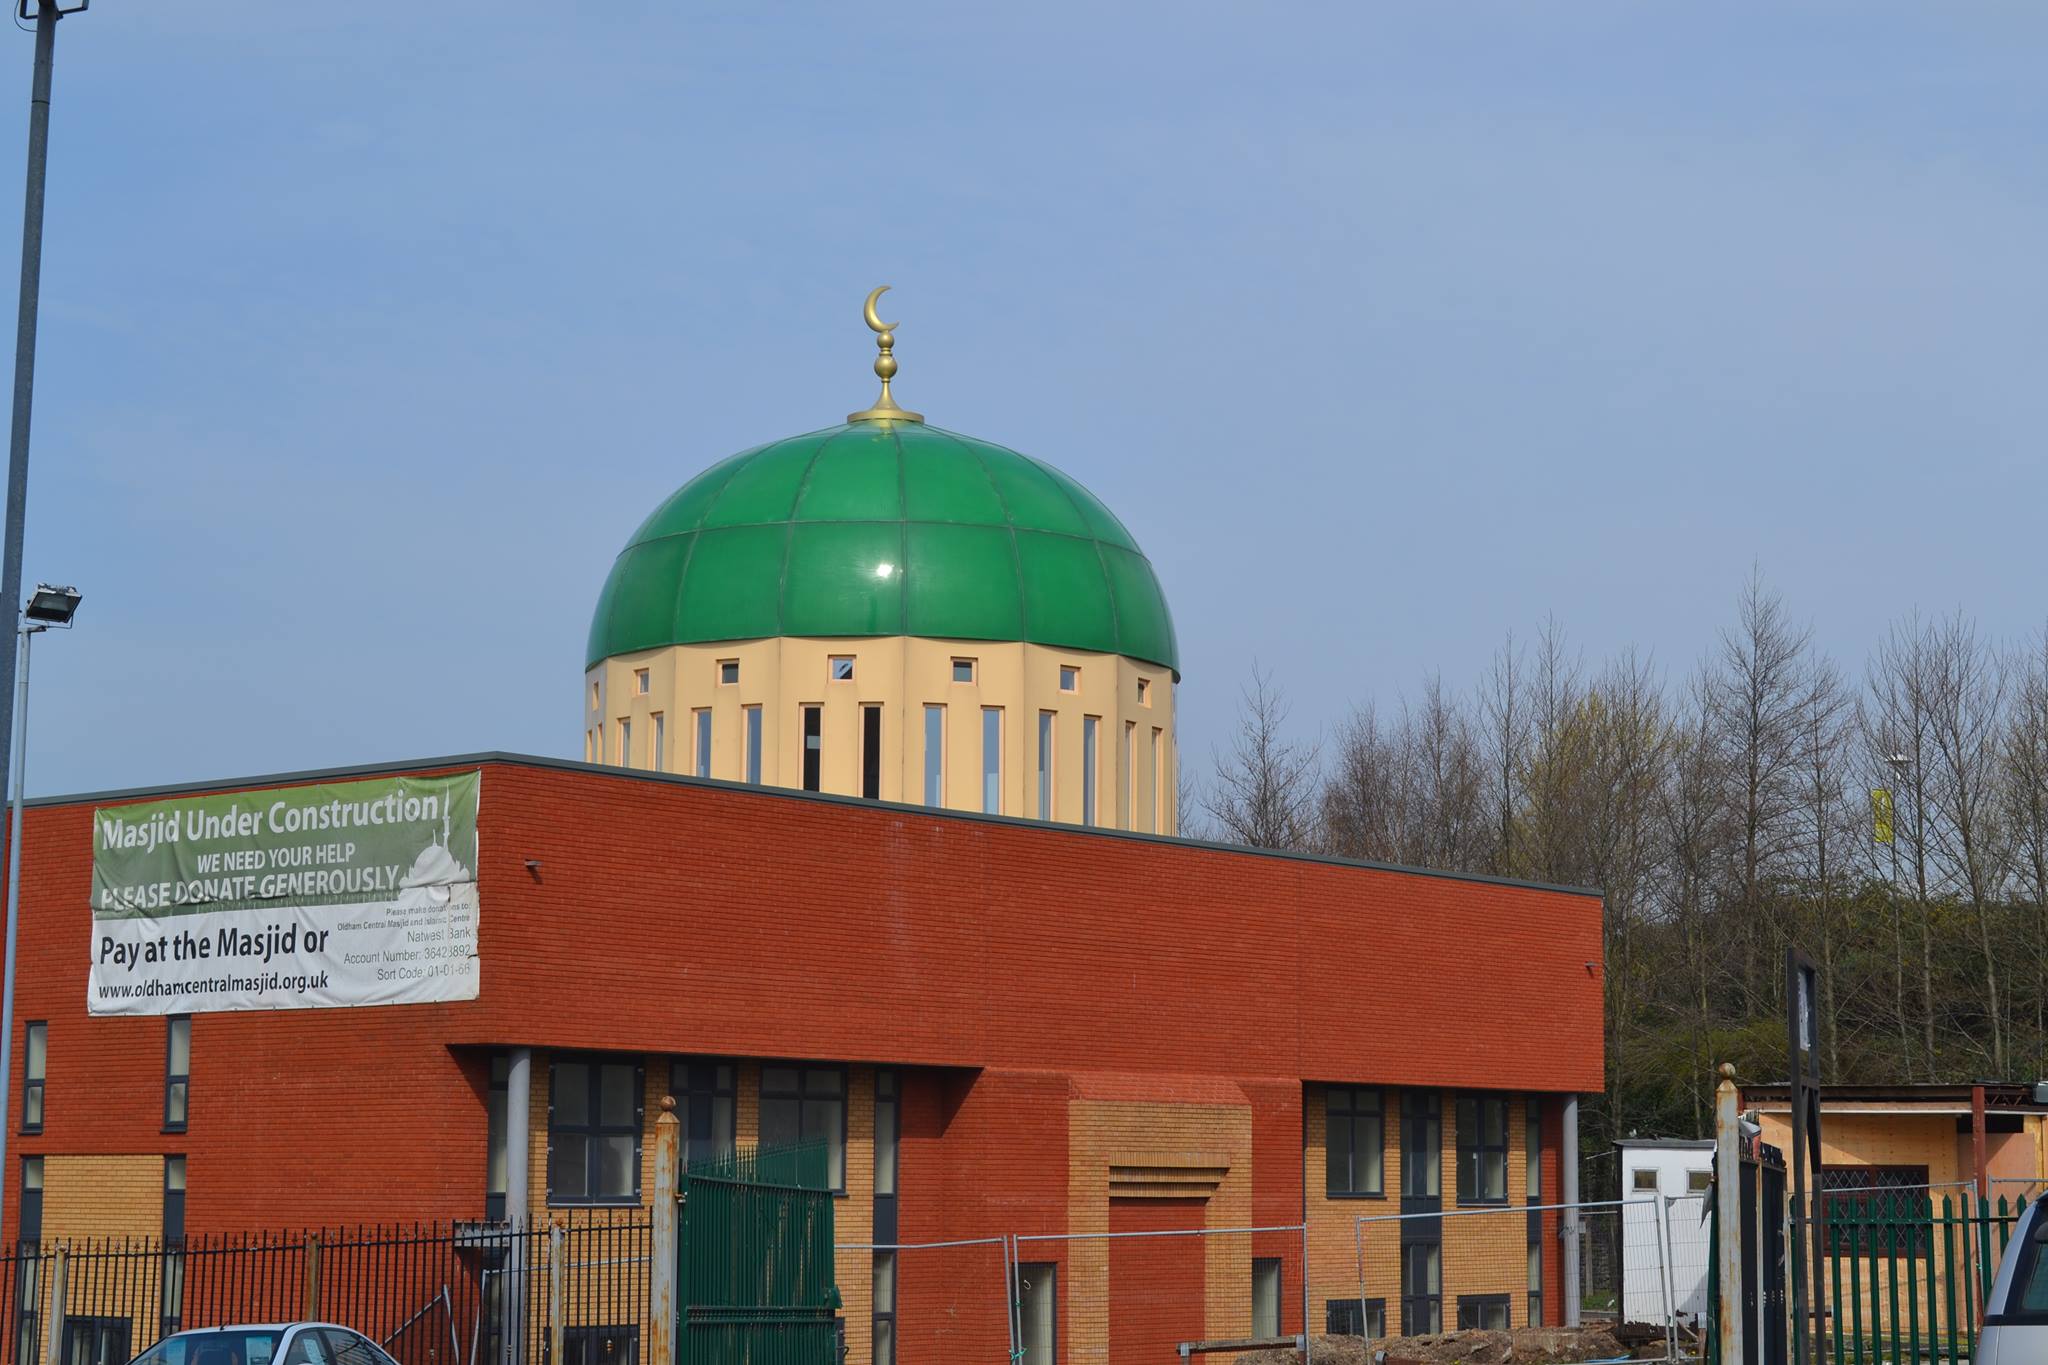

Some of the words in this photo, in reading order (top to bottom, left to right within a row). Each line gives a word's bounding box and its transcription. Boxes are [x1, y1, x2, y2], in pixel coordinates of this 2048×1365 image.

[102, 809, 181, 853] Masjid
[186, 804, 263, 841] Under
[268, 789, 439, 834] Construction
[197, 853, 220, 874] WE
[223, 850, 265, 872] NEED
[268, 845, 312, 868] YOUR
[315, 843, 356, 865] HELP
[101, 882, 171, 911] PLEASE
[174, 875, 256, 905] DONATE
[259, 864, 400, 898] GENEROUSLY
[386, 907, 407, 916] Please
[408, 905, 427, 914] make
[428, 903, 460, 913] donatns
[337, 921, 362, 931] Oldham
[363, 920, 387, 930] Central
[387, 919, 409, 929] Masjid
[410, 917, 423, 926] and
[424, 916, 447, 925] Islamic
[407, 929, 444, 943] Natwest
[448, 926, 471, 939] Bank
[100, 936, 140, 972] Pay
[144, 935, 168, 964] at
[173, 930, 211, 960] the
[217, 923, 297, 963] Masjid
[303, 929, 329, 953] or
[343, 953, 380, 964] Account
[382, 949, 422, 962] Number:
[99, 970, 329, 999] www.oldhamcentralmasjid.org.uk
[377, 968, 396, 981] Sort
[398, 966, 425, 979] Code:
